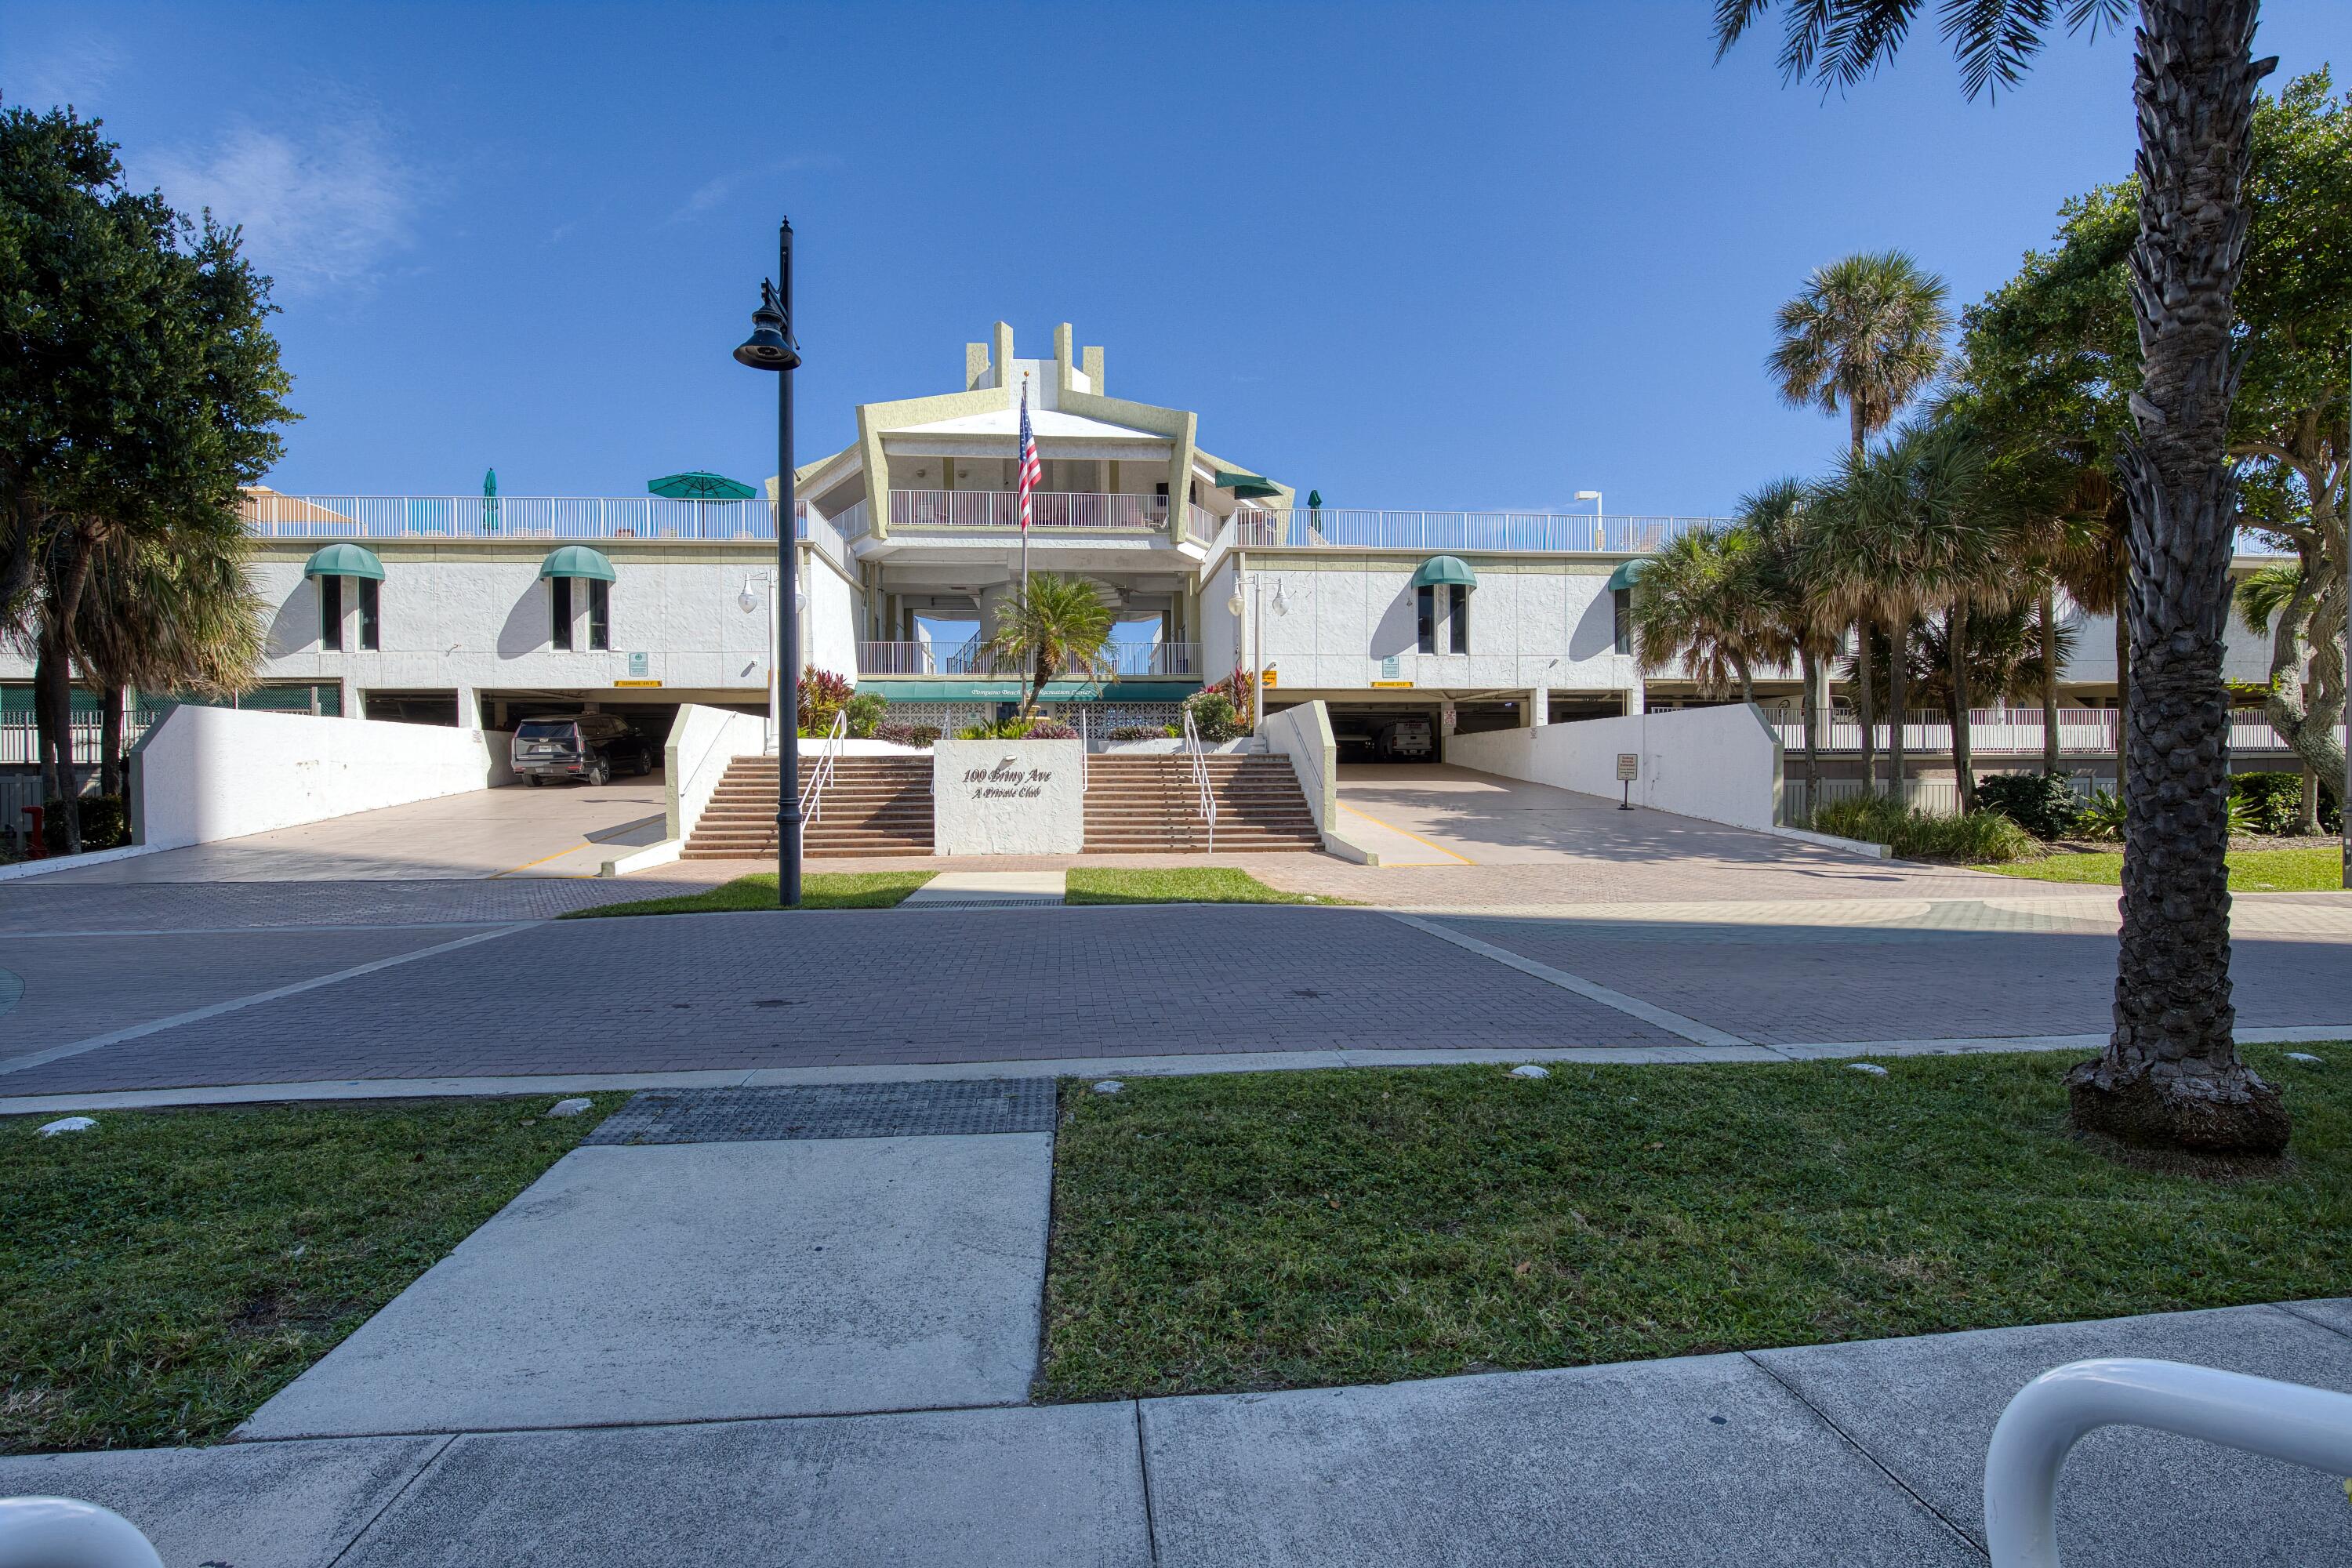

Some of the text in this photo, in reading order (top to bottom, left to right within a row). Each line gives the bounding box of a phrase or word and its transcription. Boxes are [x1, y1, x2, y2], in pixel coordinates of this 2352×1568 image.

[962, 768, 1051, 786] 100 Briny Ave
[972, 786, 1041, 799] A Private Club
